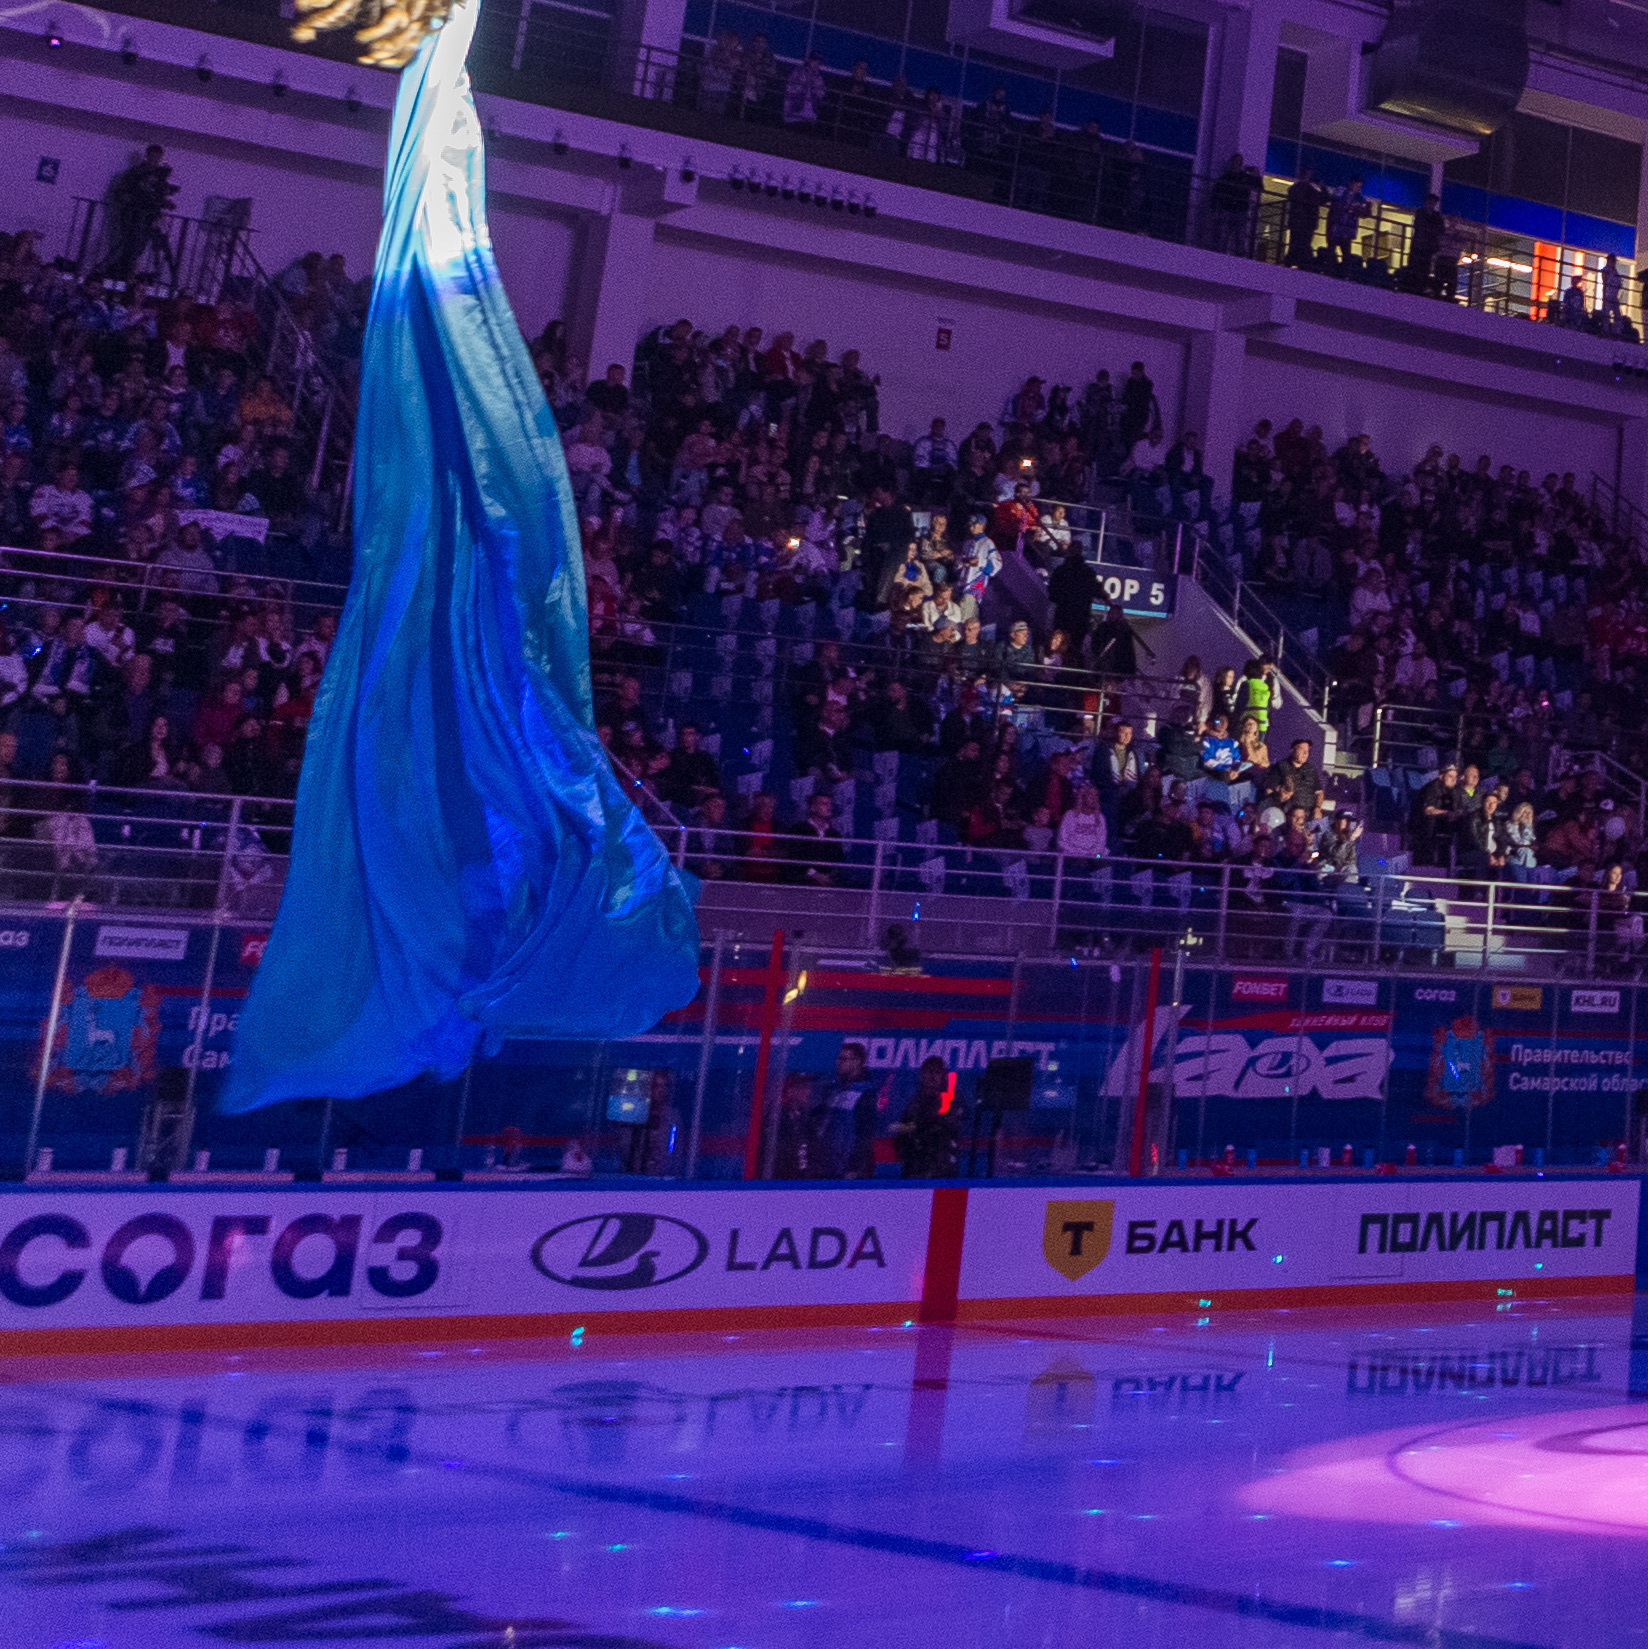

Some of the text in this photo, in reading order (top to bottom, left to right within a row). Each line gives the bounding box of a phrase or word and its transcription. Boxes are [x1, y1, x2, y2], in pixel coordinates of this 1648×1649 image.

[1149, 581, 1166, 606] 5
[1232, 980, 1289, 997] FONBET
[1511, 1044, 1633, 1066] Правительство
[1509, 1072, 1598, 1092] Самарской
[1125, 1217, 1260, 1255] БАНК
[1357, 1208, 1613, 1254] ПОЛИПЛАСТ
[725, 1224, 888, 1272] LADA
